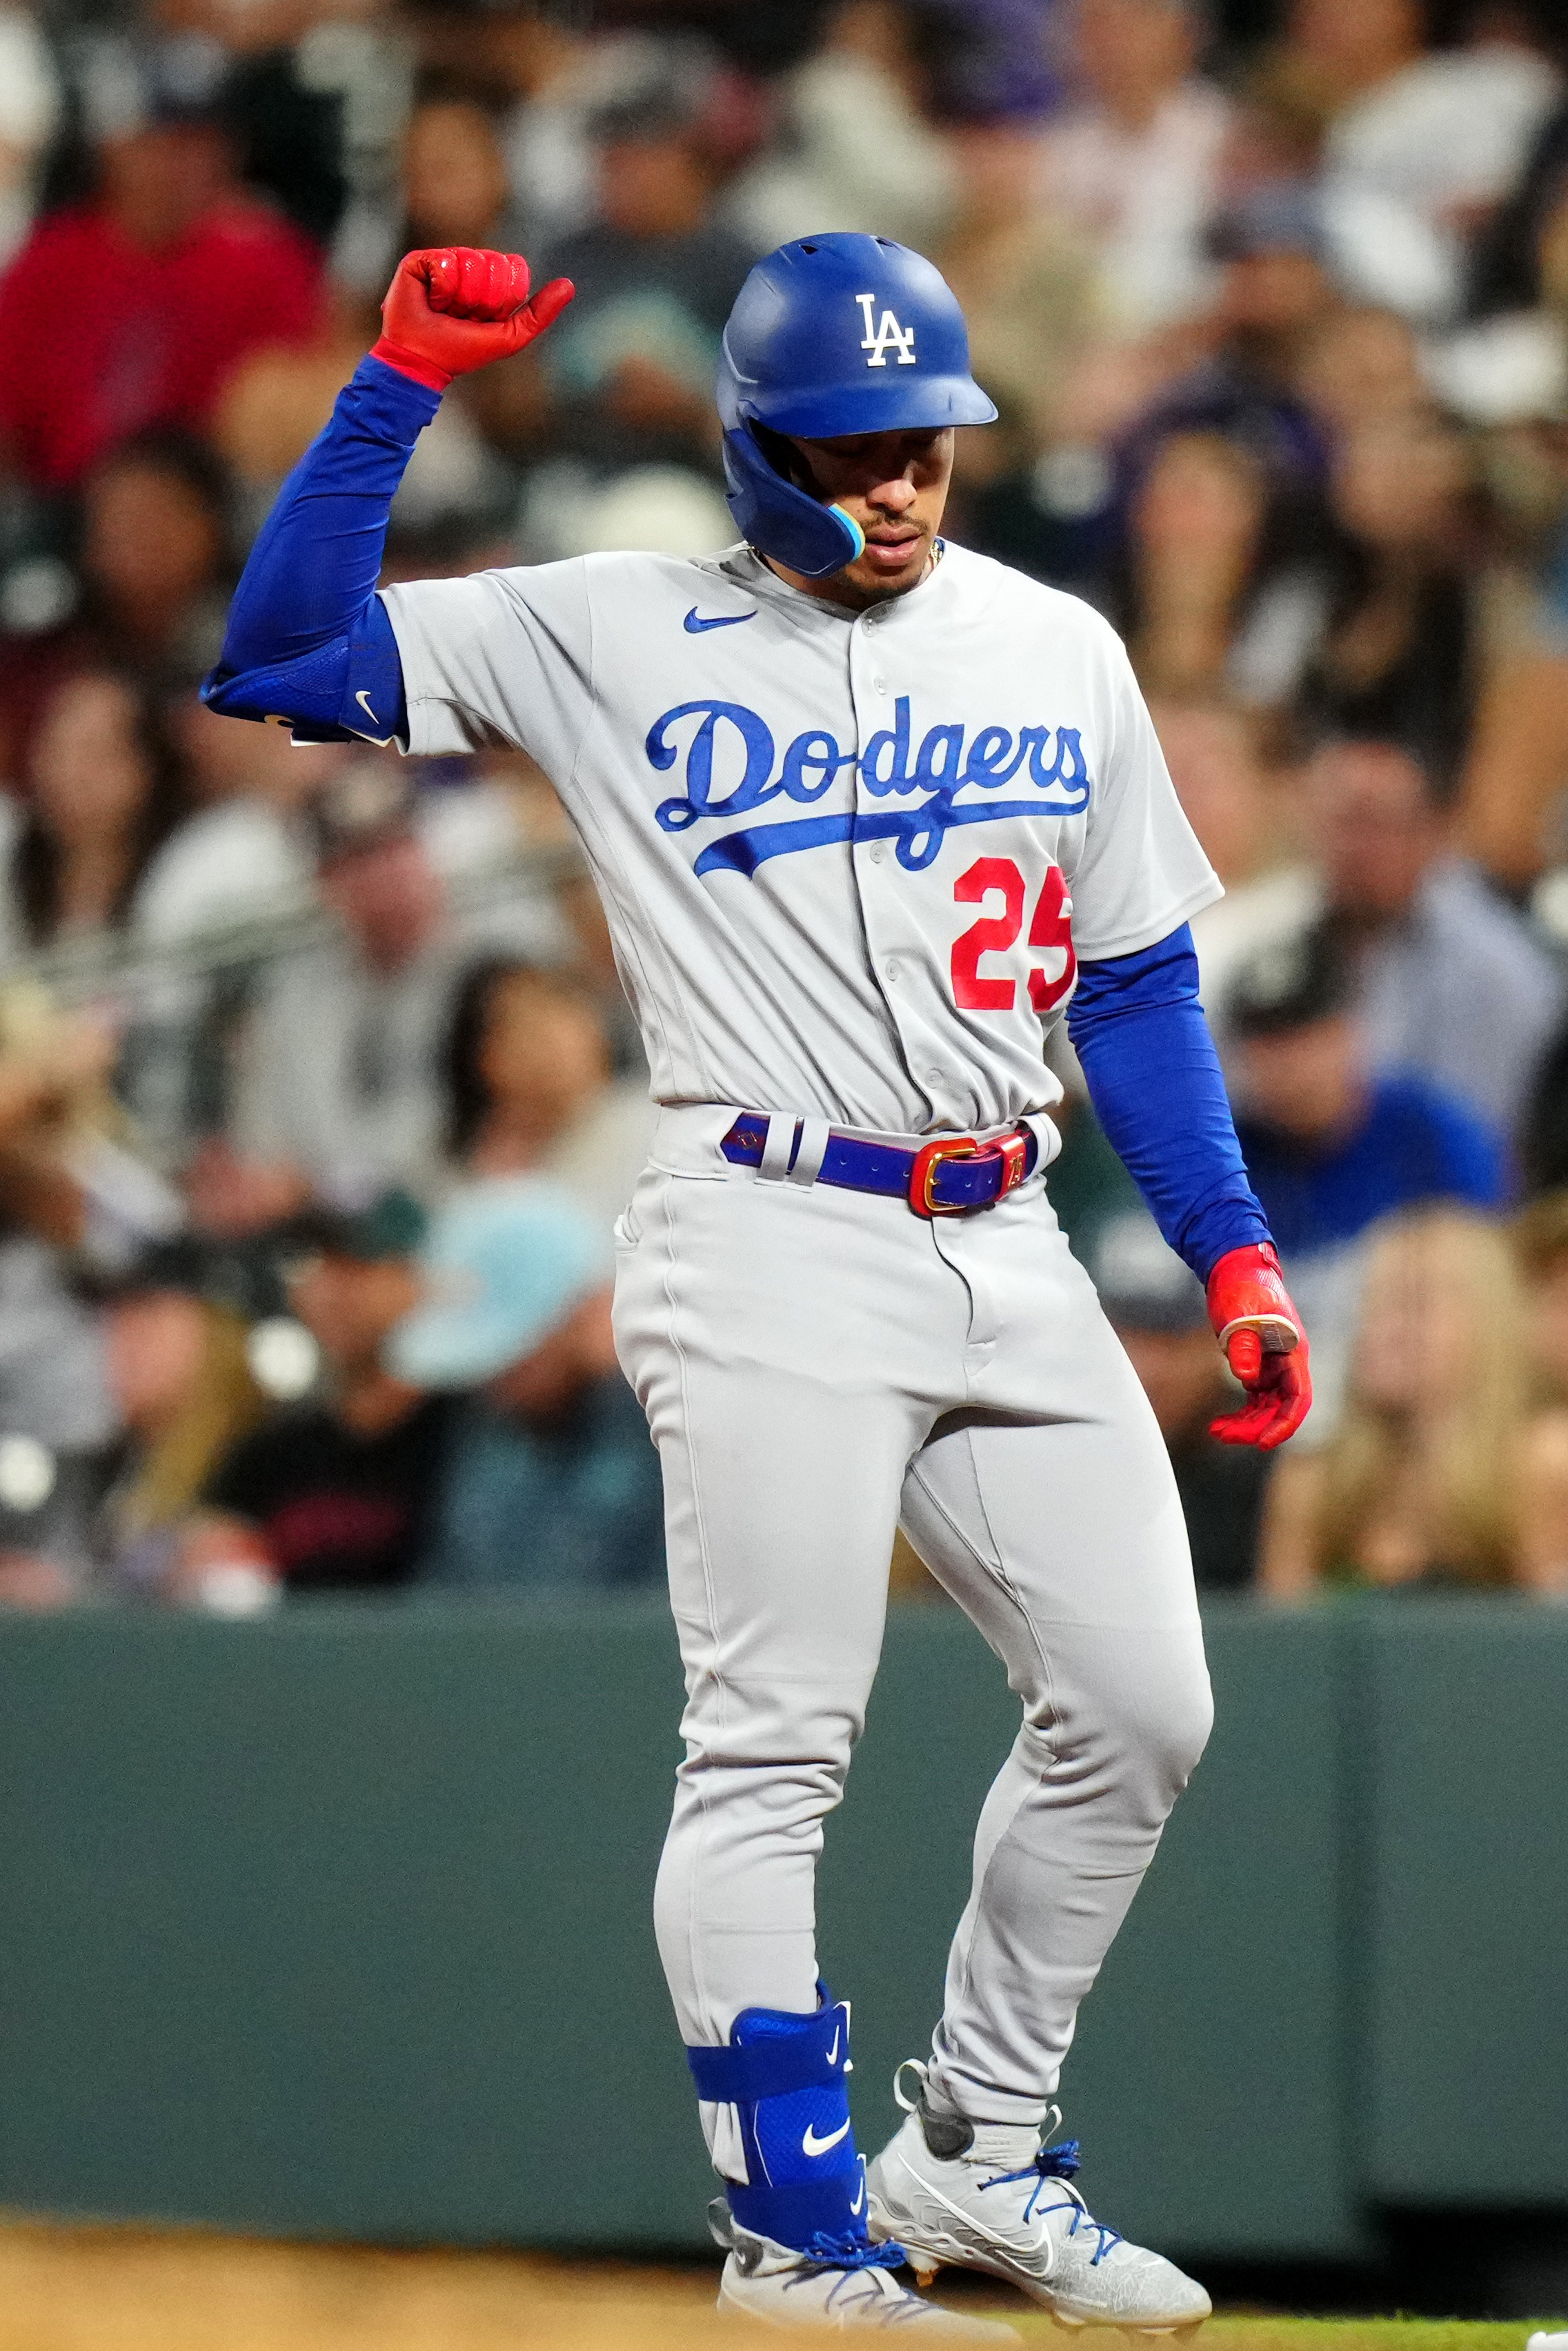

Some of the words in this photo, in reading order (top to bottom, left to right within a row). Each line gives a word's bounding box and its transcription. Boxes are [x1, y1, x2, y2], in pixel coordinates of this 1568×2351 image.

[855, 293, 916, 367] LA
[646, 695, 1089, 873] Dodgers
[951, 857, 1078, 1012] 25
